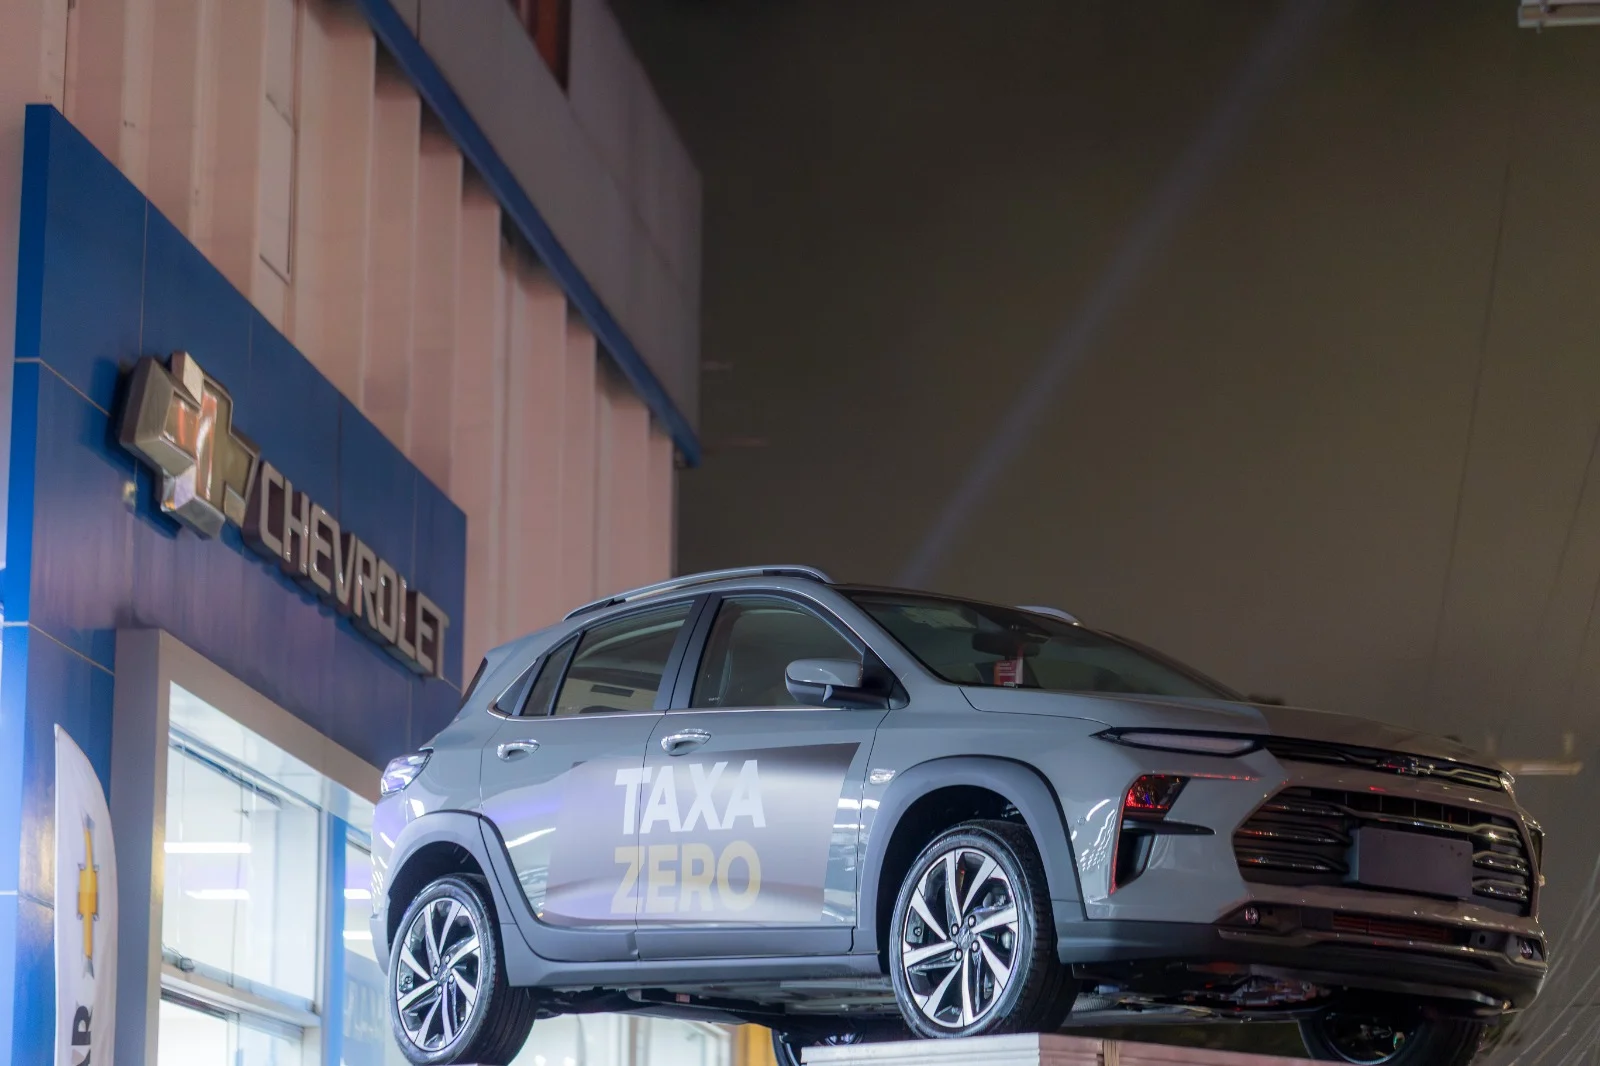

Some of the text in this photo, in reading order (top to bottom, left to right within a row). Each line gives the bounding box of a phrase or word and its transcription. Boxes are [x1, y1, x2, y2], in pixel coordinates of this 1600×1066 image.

[258, 460, 450, 680] CHEVROLET
[614, 759, 767, 835] TAXA
[610, 840, 762, 914] ZERO
